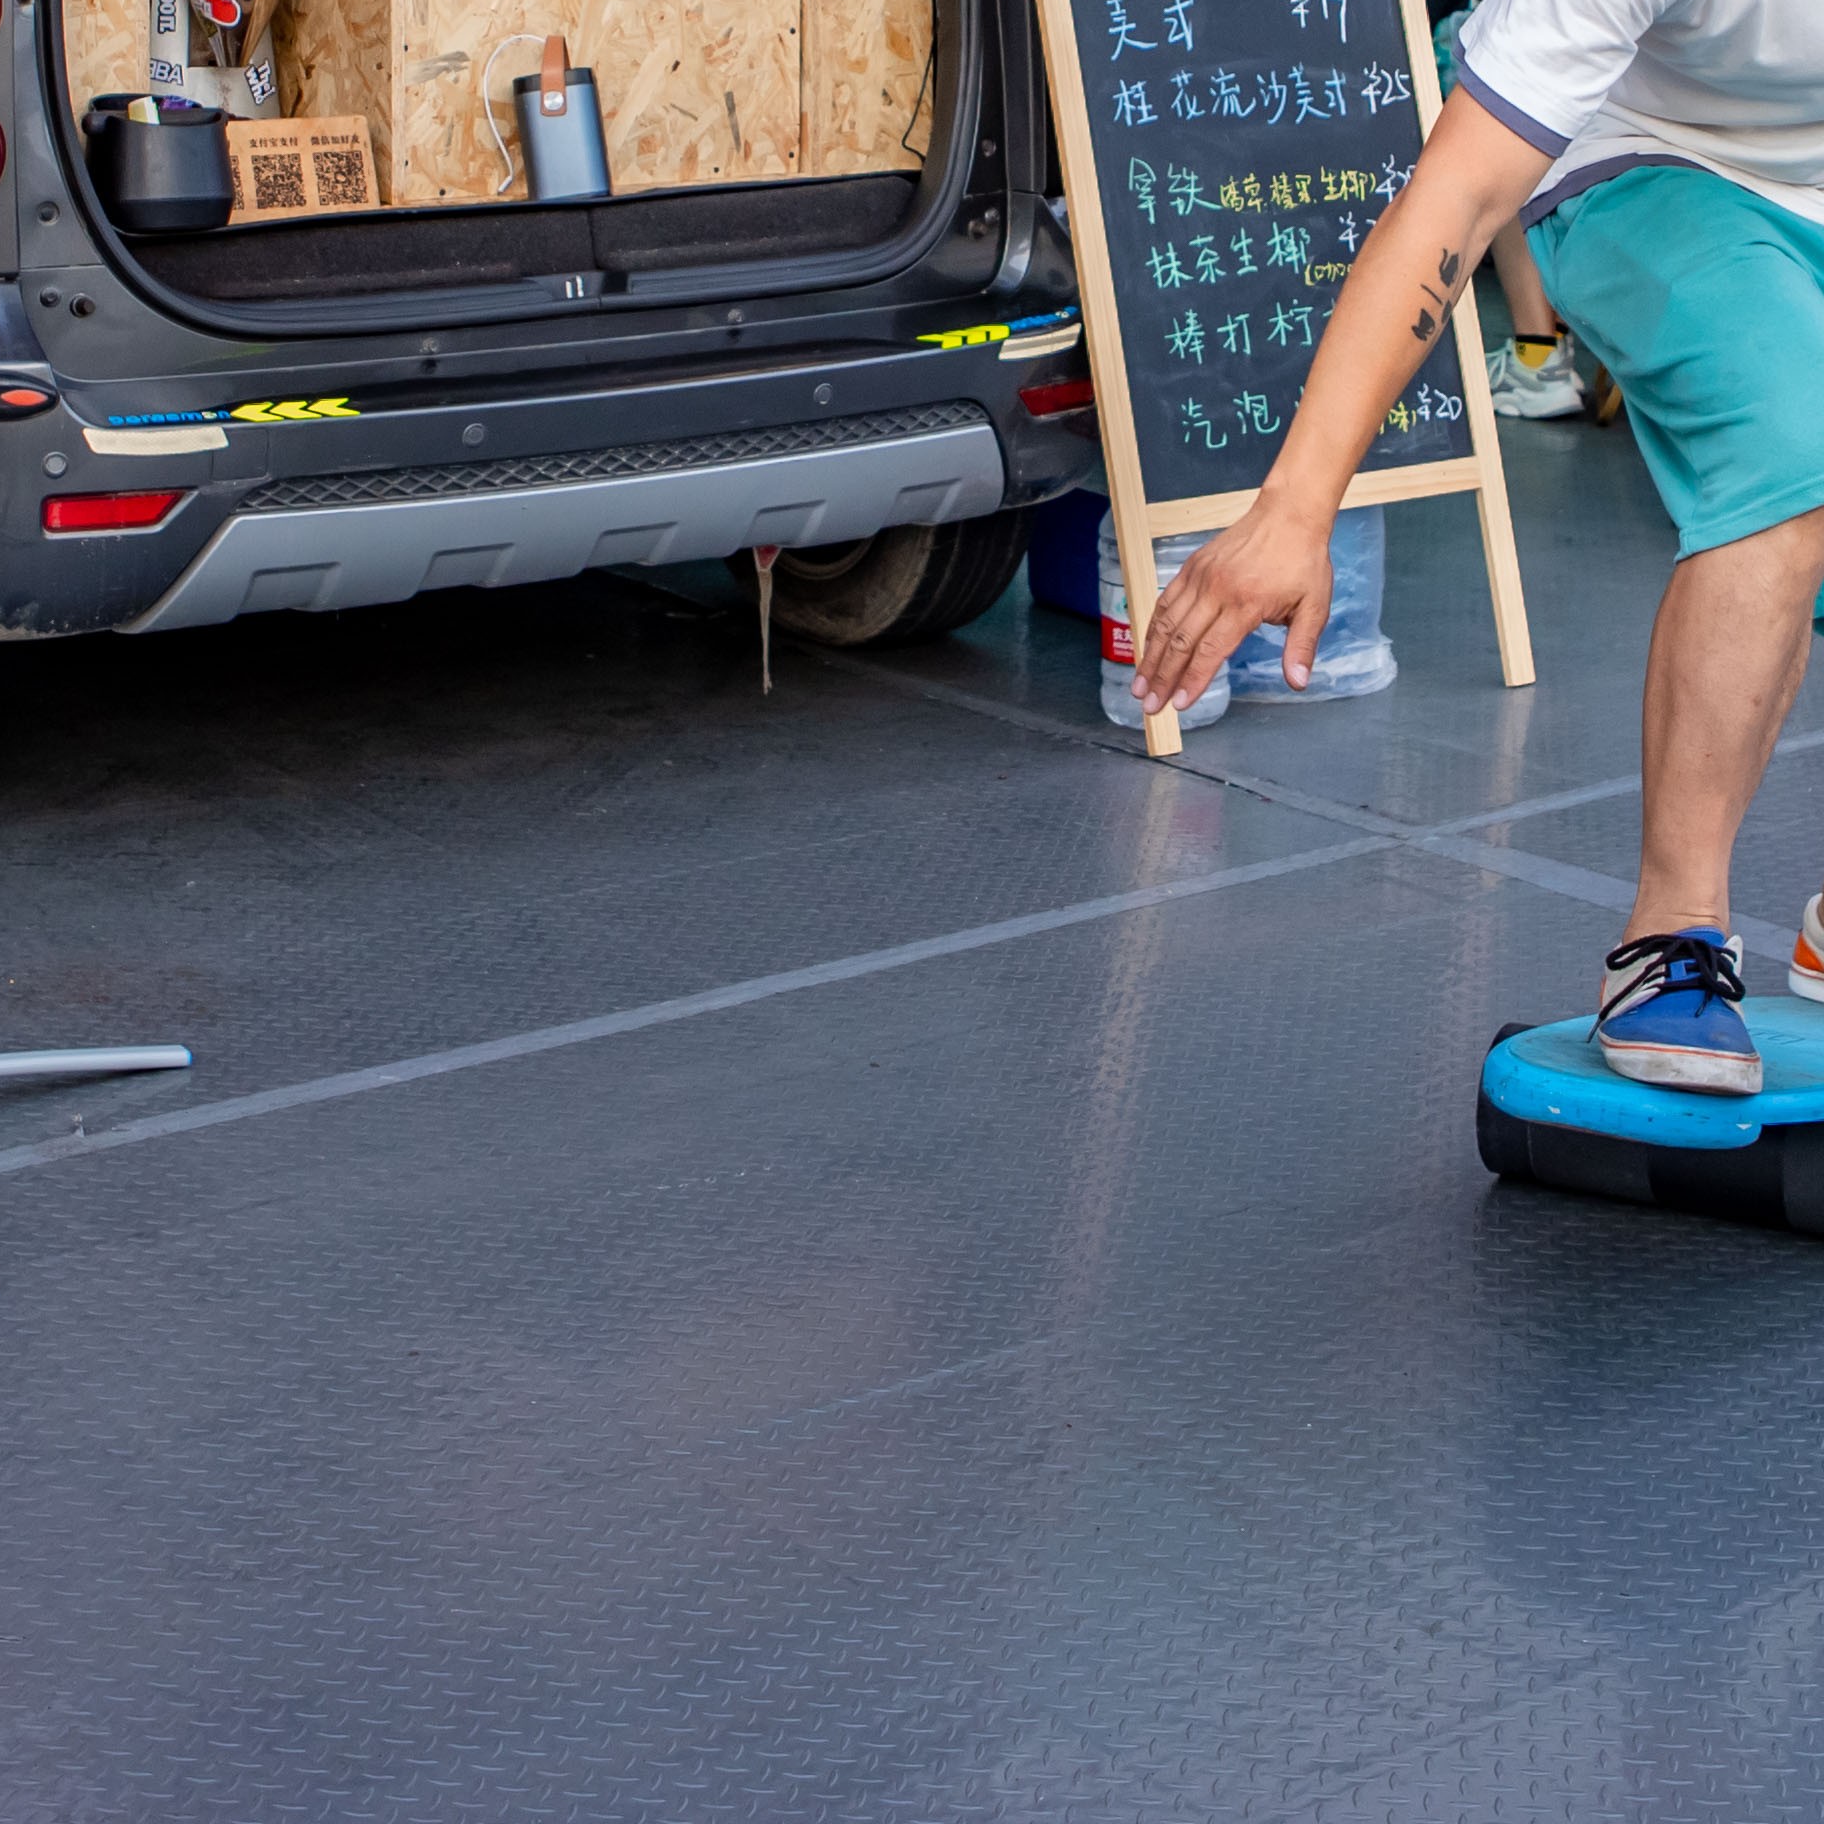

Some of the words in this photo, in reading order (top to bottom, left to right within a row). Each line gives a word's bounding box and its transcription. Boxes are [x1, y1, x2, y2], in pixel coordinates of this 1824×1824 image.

[1113, 65, 1348, 128] 桂花流沙美式
[248, 136, 299, 149] 支付宝支付
[310, 135, 361, 148] 微信加好友
[1144, 218, 1313, 291] 抹茶生椰
[1180, 384, 1305, 449] 汽泡
